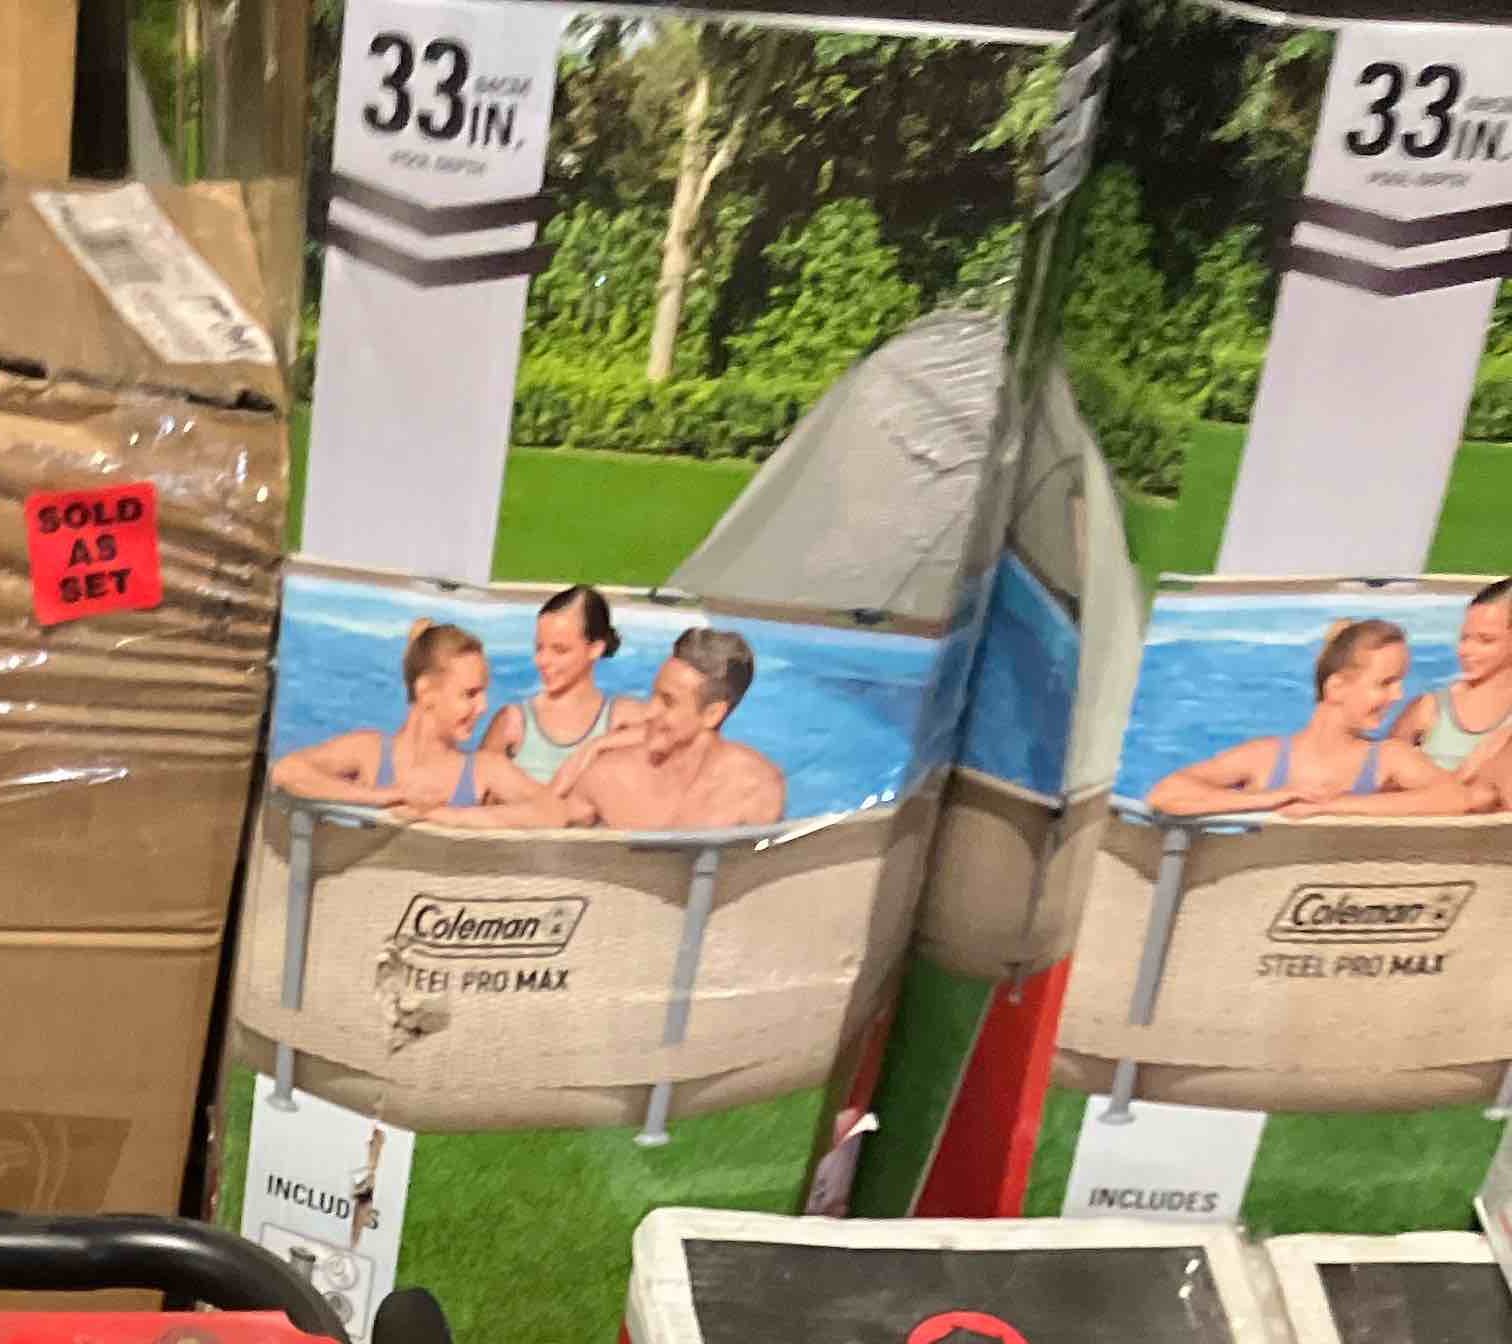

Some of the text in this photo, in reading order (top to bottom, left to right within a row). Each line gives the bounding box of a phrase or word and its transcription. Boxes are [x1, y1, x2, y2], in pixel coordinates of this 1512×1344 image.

[363, 32, 470, 141] 33
[468, 101, 526, 148] IN.
[1345, 61, 1461, 159] 33
[37, 498, 144, 534] SOLD
[69, 538, 119, 567] AS
[57, 569, 133, 602] SET
[413, 902, 539, 942] Coleman
[1289, 892, 1425, 928] Coleman
[461, 967, 508, 993] PRO
[515, 967, 569, 992] MAX
[1258, 953, 1446, 978] STEEL PRO MAX
[266, 1172, 380, 1231] INCLUDS
[1088, 1185, 1218, 1213] INCLUDES
